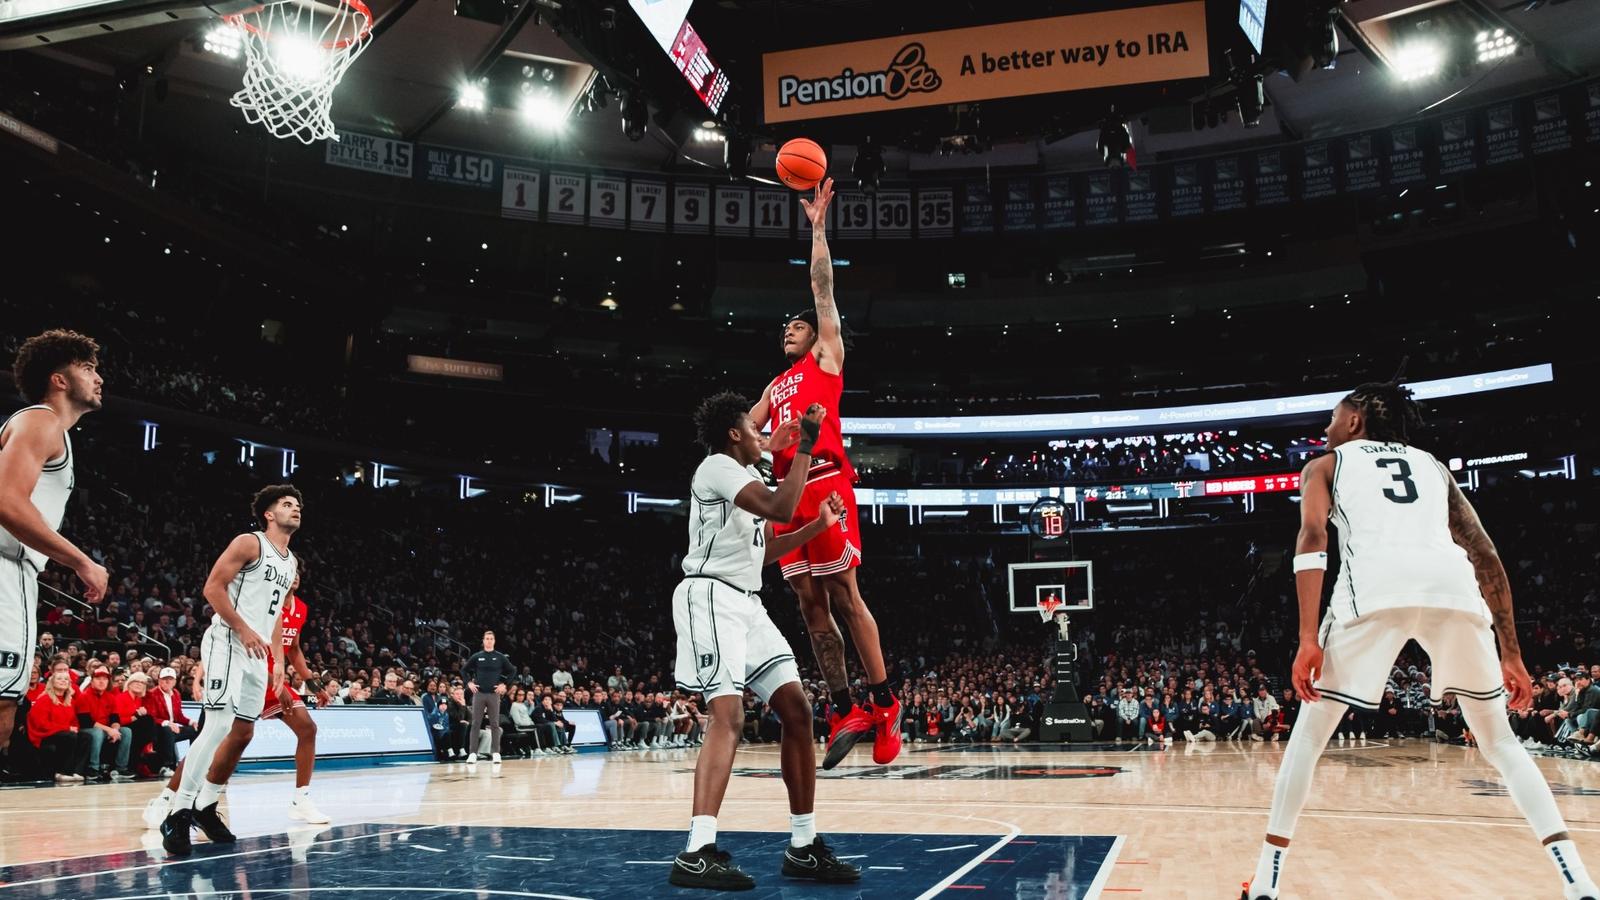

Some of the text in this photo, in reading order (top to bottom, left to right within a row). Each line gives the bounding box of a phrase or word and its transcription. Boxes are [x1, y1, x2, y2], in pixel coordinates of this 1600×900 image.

[960, 31, 1189, 76] A better way to IRA
[780, 42, 942, 107] PensionBee
[330, 143, 378, 162] STYLES
[383, 141, 409, 168] 15
[452, 154, 493, 183] 150
[514, 182, 526, 208] 1
[558, 187, 575, 212] 2
[600, 191, 616, 216] 3
[640, 194, 657, 220] 7
[684, 197, 699, 222] 9
[725, 200, 740, 225] 9
[761, 202, 783, 227] 11
[841, 203, 868, 228] 19
[879, 203, 908, 227] 30
[920, 202, 951, 227] 35
[443, 363, 469, 375] SUITE
[472, 366, 500, 378] LEVEL
[771, 372, 804, 398] TEXAS
[771, 384, 798, 409] TECH
[778, 402, 792, 425] 15
[847, 420, 897, 432] Cybersecurity
[1360, 445, 1407, 454] EVANS
[1466, 452, 1528, 467] @THEGARDEN
[1084, 488, 1098, 498] 76
[1133, 487, 1149, 496] 74
[1375, 457, 1419, 504] 3
[1105, 491, 1127, 500] 2:21
[1046, 516, 1063, 535] 18
[268, 589, 280, 616] 2
[281, 627, 298, 637] XAS
[281, 636, 294, 646] CH
[1053, 717, 1086, 725] SentinelOne
